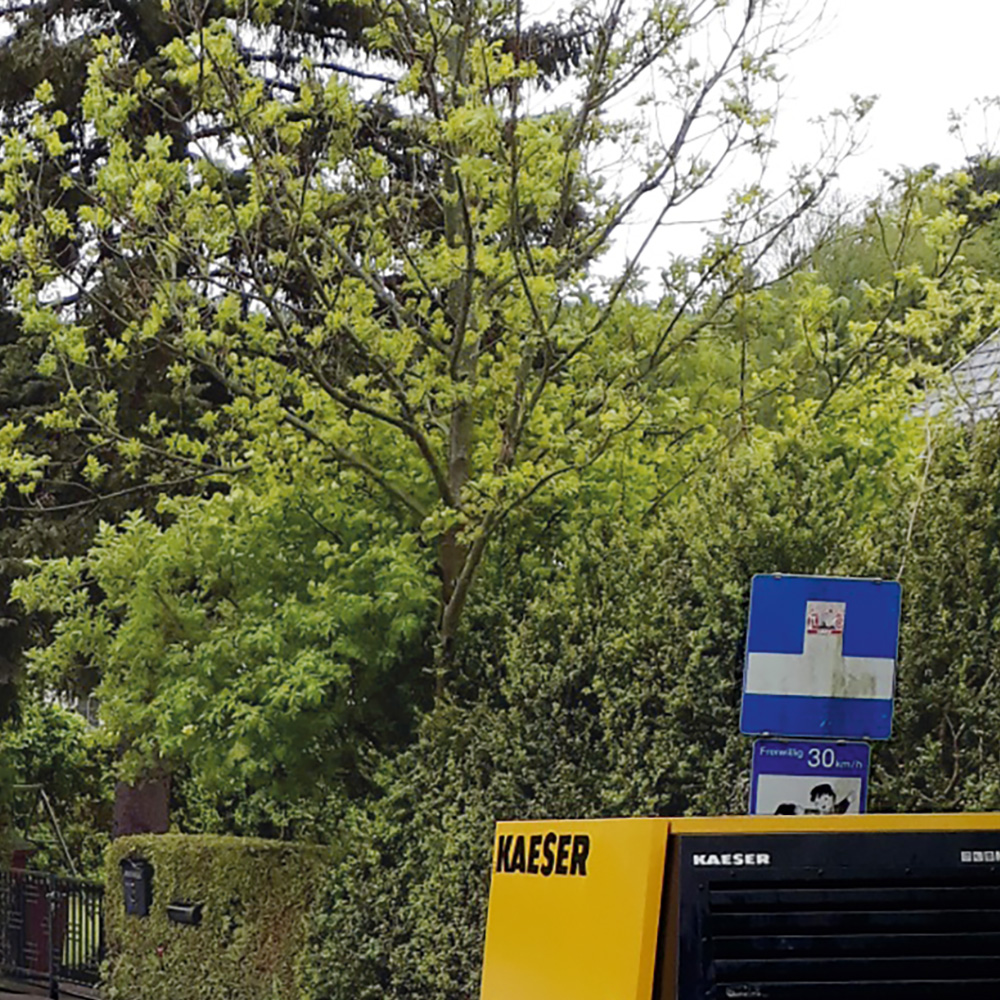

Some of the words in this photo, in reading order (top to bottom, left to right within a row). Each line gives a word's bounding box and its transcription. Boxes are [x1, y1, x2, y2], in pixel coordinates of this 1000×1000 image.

[807, 748, 834, 767] 30
[835, 760, 862, 769] km/h
[496, 832, 590, 876] KAESER
[693, 853, 770, 865] KAESER
